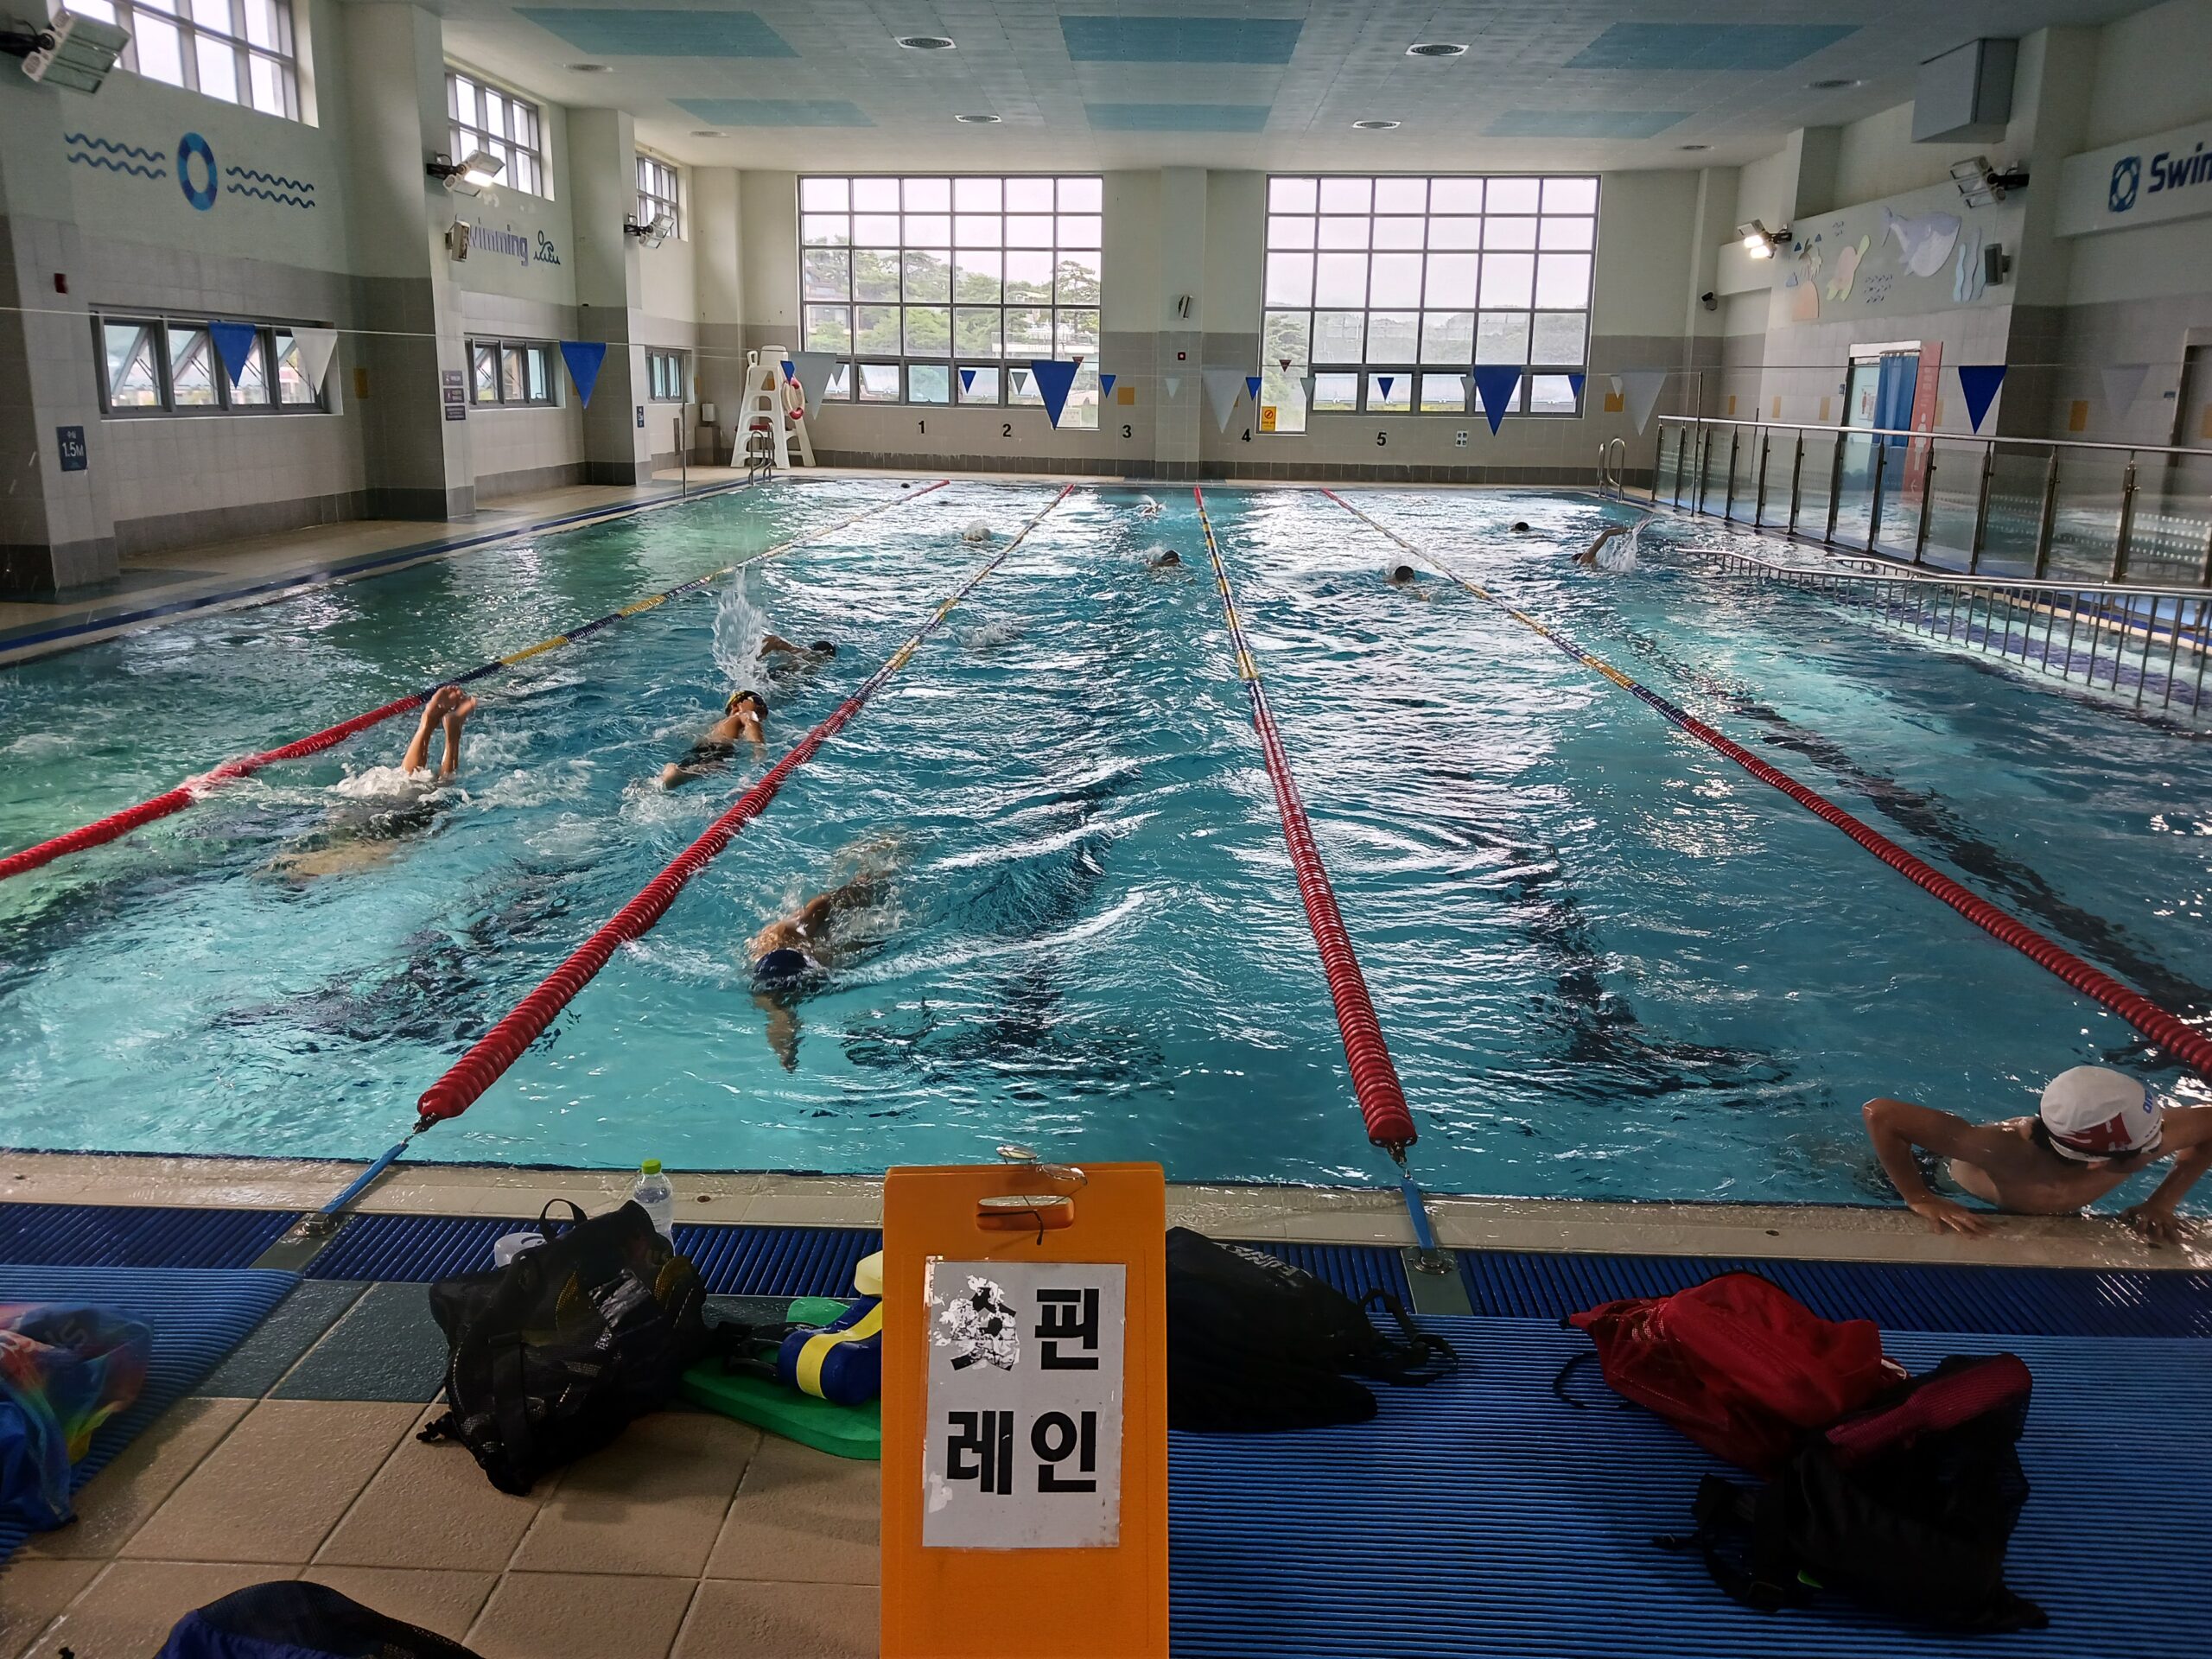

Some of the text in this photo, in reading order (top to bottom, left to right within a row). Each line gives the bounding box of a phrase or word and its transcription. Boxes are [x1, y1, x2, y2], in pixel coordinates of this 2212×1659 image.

[467, 216, 529, 266] wimming
[918, 421, 925, 434] 1
[1002, 423, 1012, 437] 2
[1122, 425, 1132, 438] 3
[1241, 429, 1252, 442] 4
[1376, 431, 1387, 447] 5
[946, 1409, 1098, 1497] 레인
